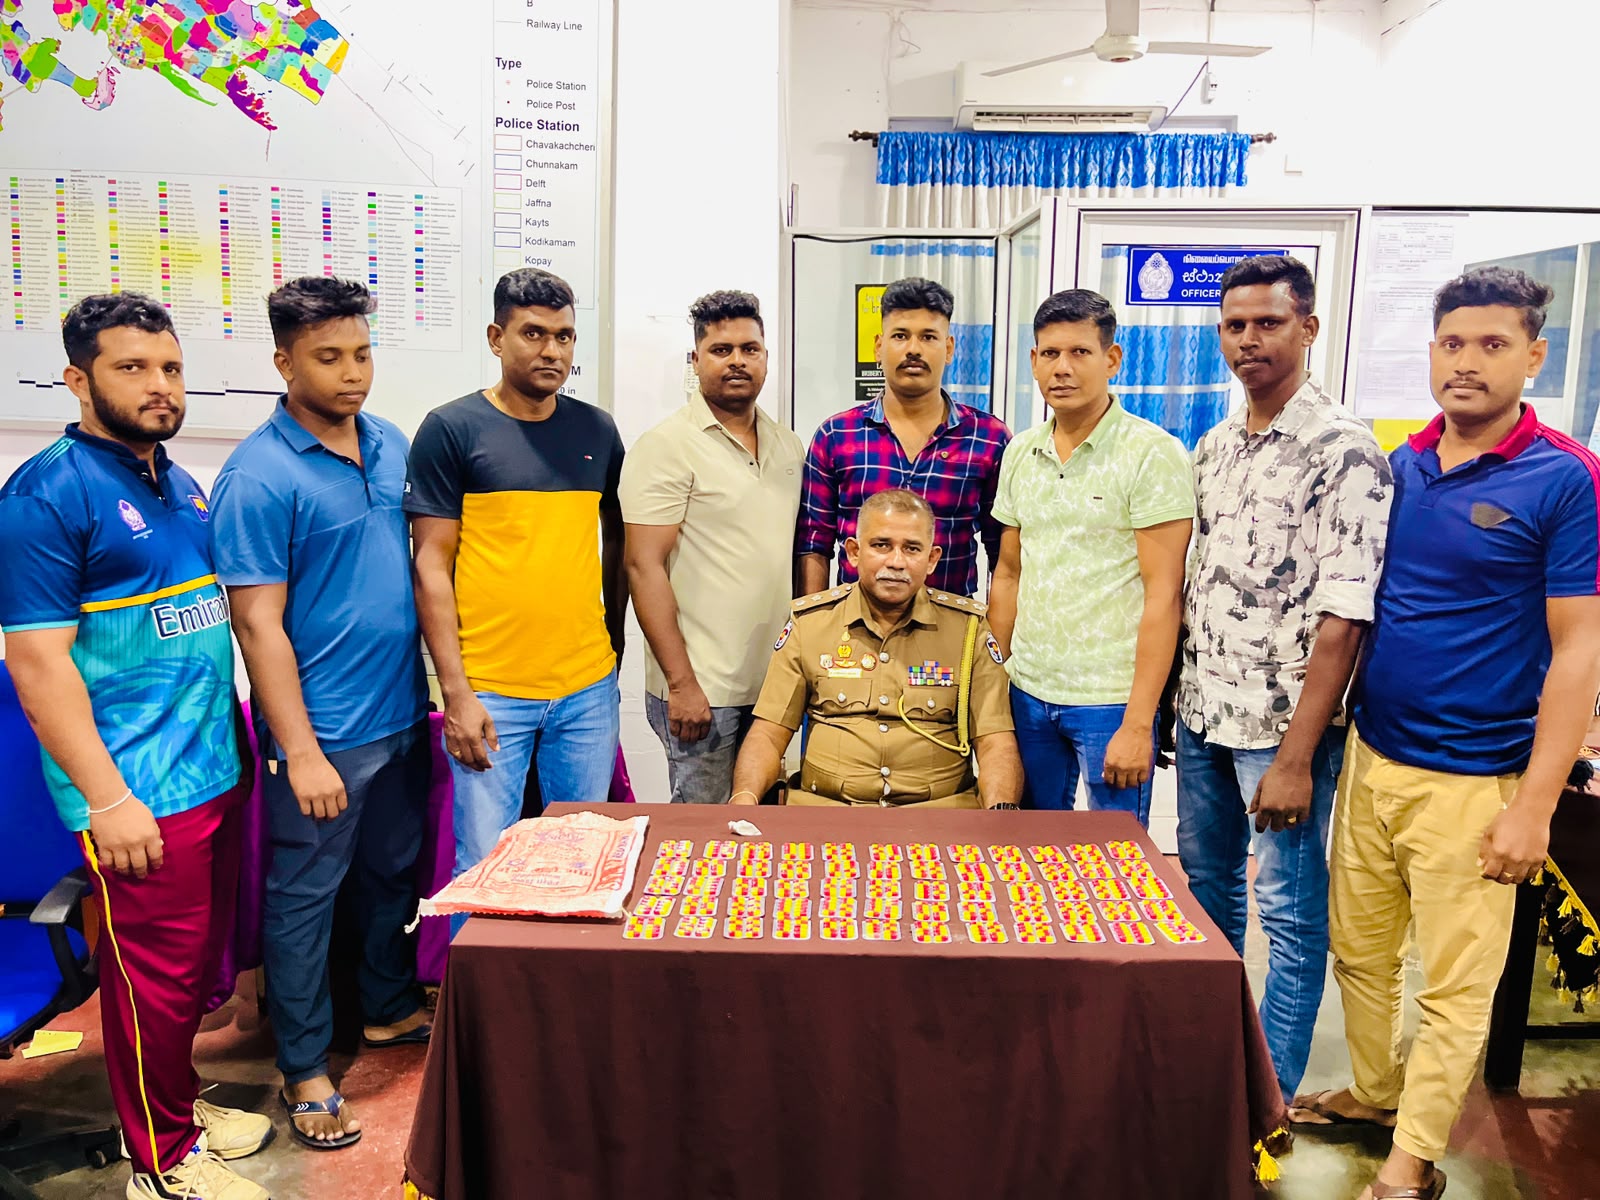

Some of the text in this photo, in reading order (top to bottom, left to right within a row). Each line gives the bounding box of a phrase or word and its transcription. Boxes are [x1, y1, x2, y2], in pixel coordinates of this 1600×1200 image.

[526, 19, 583, 31] Railway Line
[495, 57, 522, 70] Type
[526, 79, 587, 91] Police Station
[526, 99, 576, 111] Police Post
[495, 117, 580, 132] Police Station
[526, 159, 578, 171] Chunnakam
[525, 178, 546, 189] Delft
[525, 198, 552, 209] Jaffna
[525, 218, 550, 229] Kayts
[525, 237, 576, 248] Kodikamam
[525, 256, 552, 267] Kopay
[1181, 288, 1221, 298] OFFICER
